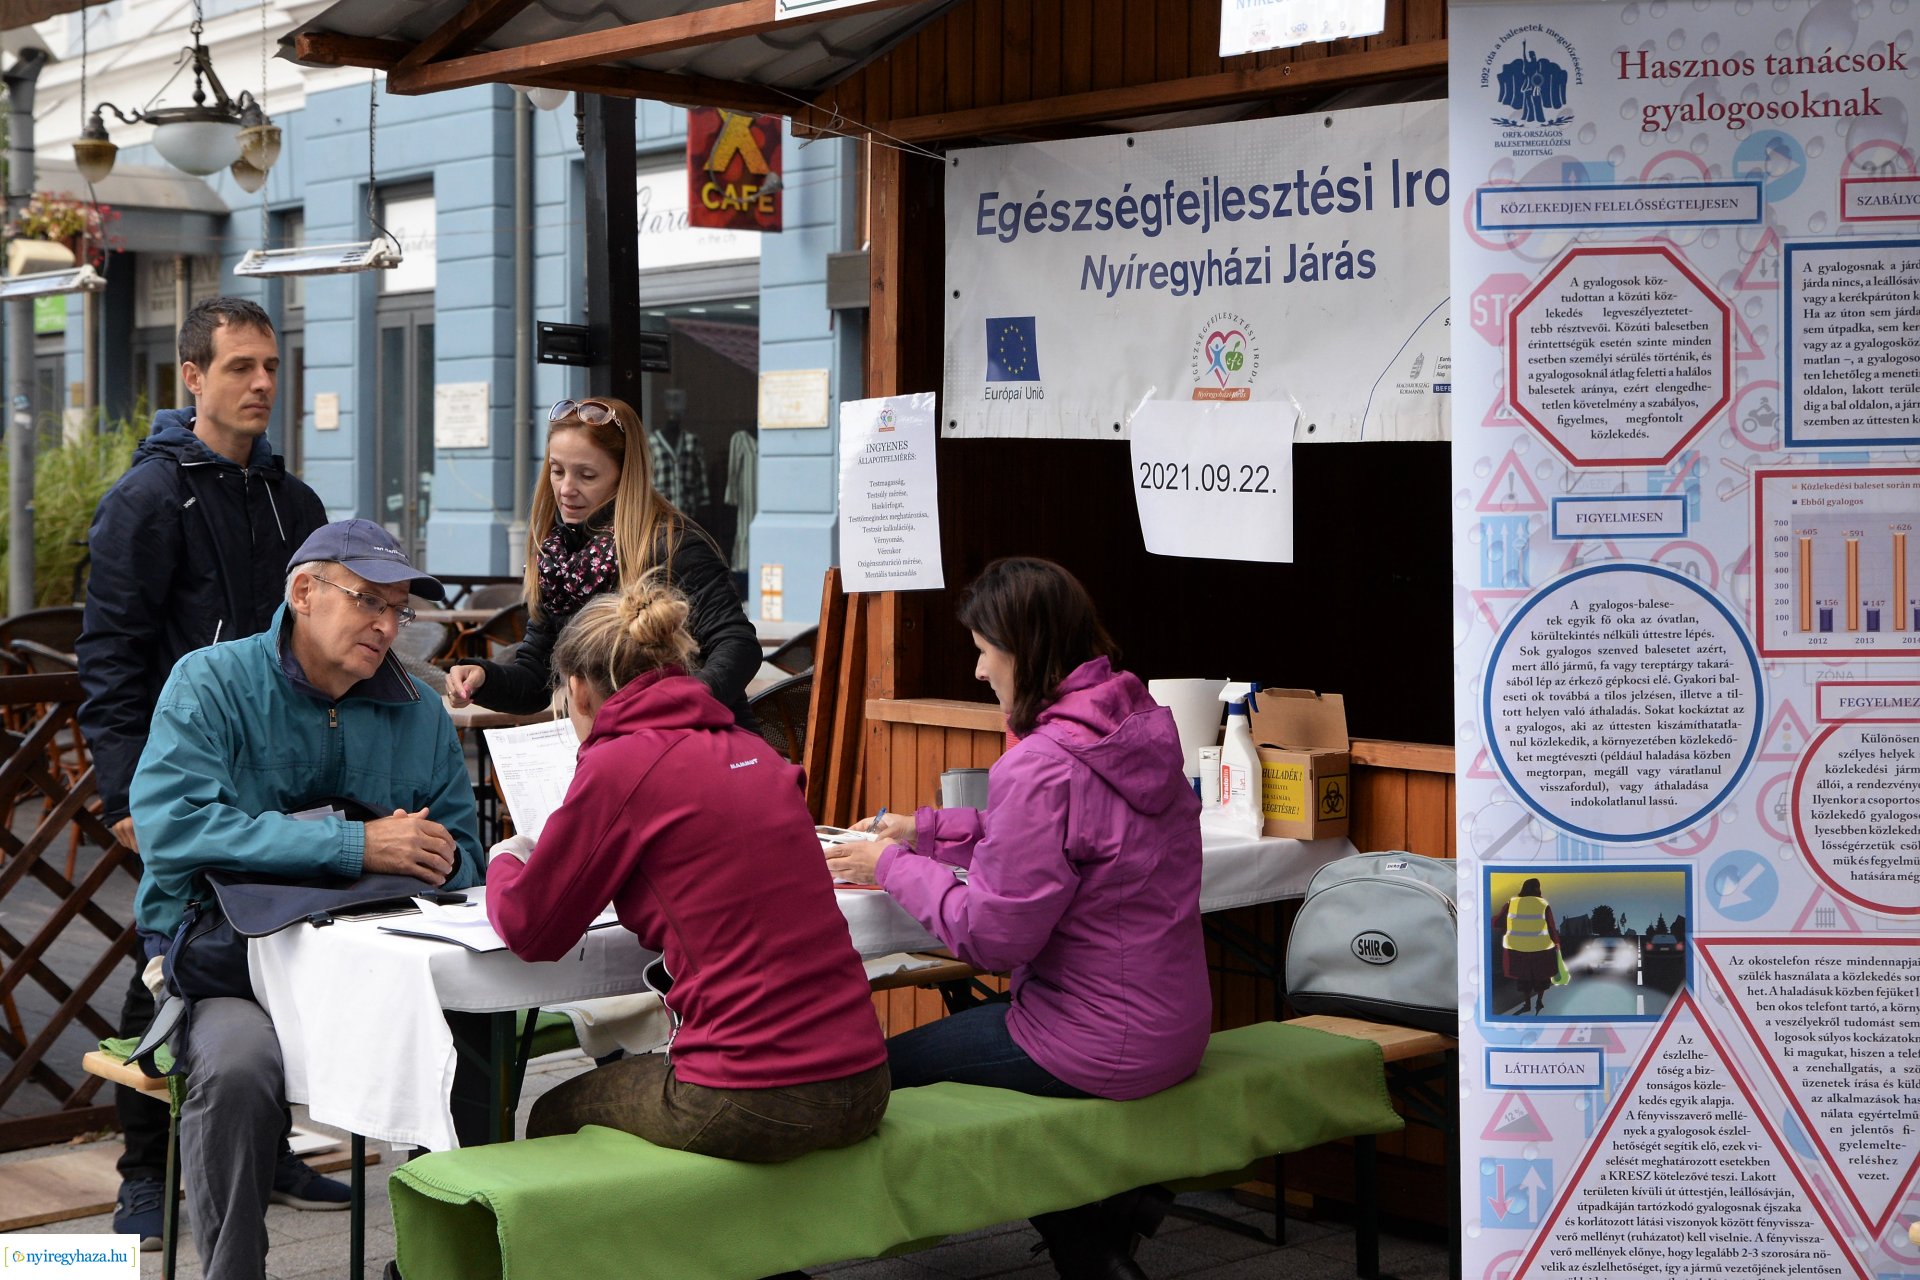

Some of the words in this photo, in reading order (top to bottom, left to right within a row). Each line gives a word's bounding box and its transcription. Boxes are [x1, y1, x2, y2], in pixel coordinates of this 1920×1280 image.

[1481, 68, 1490, 88] 1992
[1486, 51, 1497, 66] óta
[1499, 24, 1544, 43] balesetek
[1546, 27, 1583, 86] megelőzéséért
[1617, 51, 1754, 79] Hasznos
[1764, 42, 1908, 75] tanácsok
[1641, 87, 1883, 133] gyalogosoknak
[1503, 130, 1563, 138] ORFK-ORSZÁGOS
[1495, 138, 1571, 147] BALESETMEGELŐZÉSI
[976, 162, 1373, 243] Egészségfejlesztési
[1392, 159, 1449, 208] Iro
[1501, 202, 1591, 214] KÖZLEKEDJEN
[1595, 198, 1738, 211] FELELŐSSÉGTELJESEN
[1081, 246, 1270, 298] Nyíregyházi
[1284, 240, 1376, 283] Járás
[1570, 277, 1579, 287] A
[1583, 276, 1641, 290] gyalogosok
[1645, 276, 1668, 285] köz-
[1561, 292, 1604, 302] tudottan
[1618, 292, 1650, 301] közúti
[1654, 291, 1677, 300] köz-
[1546, 308, 1583, 318] lekedés
[1603, 306, 1693, 320] legveszélyeztetet-
[1531, 324, 1552, 333] tebb
[1557, 323, 1610, 333] résztvevői.
[1616, 322, 1650, 332] Közúti
[1655, 321, 1708, 331] balesetben
[1528, 338, 1595, 351] érintettségük
[1600, 338, 1631, 347] esetén
[1637, 338, 1667, 346] szinte
[1672, 336, 1711, 346] minden
[1528, 354, 1566, 364] esetben
[1570, 353, 1612, 366] személyi
[1616, 352, 1651, 362] sérülés
[1654, 351, 1699, 362] történik,
[1701, 352, 1711, 360] és
[1536, 368, 1607, 382] gyalogosoknál
[1610, 368, 1635, 380] átlag
[1637, 367, 1666, 377] feletti
[1676, 366, 1712, 376] halálos
[985, 387, 1022, 402] Európai
[1026, 386, 1044, 399] Unió
[1529, 384, 1575, 394] balesetek
[1581, 385, 1617, 396] aránya,
[1624, 384, 1649, 392] ezért
[1655, 381, 1711, 395] elengedhe-
[1542, 400, 1570, 409] tetlen
[1573, 399, 1637, 411] követelmény
[1648, 397, 1698, 410] szabályos,
[1558, 415, 1607, 427] figyelmes,
[1626, 412, 1683, 426] megfontolt
[1591, 429, 1649, 439] közlekedés.
[867, 440, 908, 453] INGYENES
[1140, 462, 1276, 493] 2021.09.22.
[1801, 498, 1825, 506] Ebből
[1826, 498, 1864, 507] gyalogos
[1577, 513, 1662, 523] FIGYELMESEN
[1570, 600, 1579, 610] A
[1589, 599, 1674, 612] gyalogos-balese-
[1547, 616, 1562, 625] tek
[1568, 615, 1595, 628] egyik
[1601, 615, 1611, 624] fő
[1617, 614, 1635, 624] oka
[1657, 614, 1699, 624] óvatlan,
[1838, 749, 1875, 761] szélyes
[1880, 749, 1915, 761] helyek
[1677, 1035, 1693, 1044] Az
[1663, 1050, 1708, 1059] észlelhe-
[1505, 1062, 1584, 1074] LÁTHATÓAN
[1657, 1066, 1684, 1077] tőség
[1695, 1065, 1715, 1074] biz-
[1647, 1081, 1691, 1093] tonságos
[1694, 1080, 1725, 1090] közle-
[1850, 1124, 1894, 1136] jelentős
[1903, 1125, 1915, 1134] fi-
[1839, 1139, 1906, 1152] gyelemelte-
[1849, 1155, 1898, 1165] reléshez
